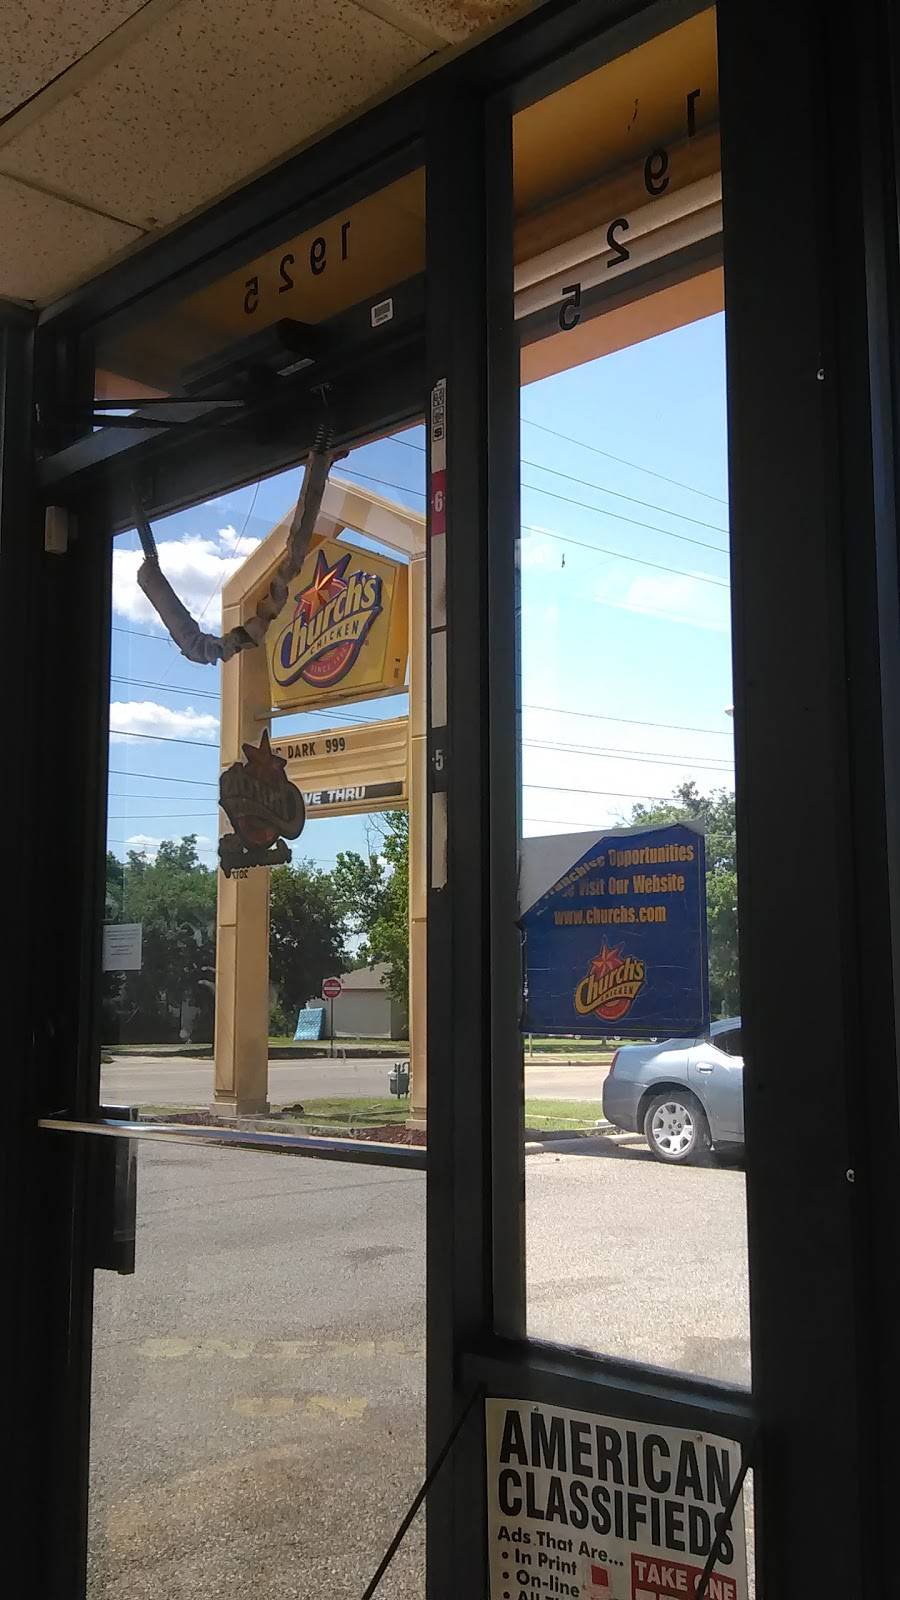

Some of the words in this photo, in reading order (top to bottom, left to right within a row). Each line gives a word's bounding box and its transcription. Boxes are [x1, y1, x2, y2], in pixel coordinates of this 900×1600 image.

[273, 570, 380, 685] Church's
[310, 620, 360, 655] CHICKEN
[287, 741, 316, 759] DARK
[325, 737, 346, 753] 999
[327, 785, 366, 805] THRU
[608, 843, 694, 868] Opportunities
[578, 878, 605, 897] Visit
[608, 876, 629, 896] Our
[633, 873, 685, 895] Website
[554, 905, 667, 925] www.churchs.com
[575, 958, 645, 1014] Church's
[500, 1410, 732, 1507] AMERICAN
[498, 1468, 734, 1566] CLASSIFIEDS
[498, 1525, 531, 1544] Ads
[536, 1531, 573, 1552] That
[578, 1541, 624, 1567] Are...
[515, 1548, 532, 1565] In
[538, 1552, 577, 1576] Print
[635, 1561, 688, 1591] TAKE
[516, 1570, 580, 1598] On-line
